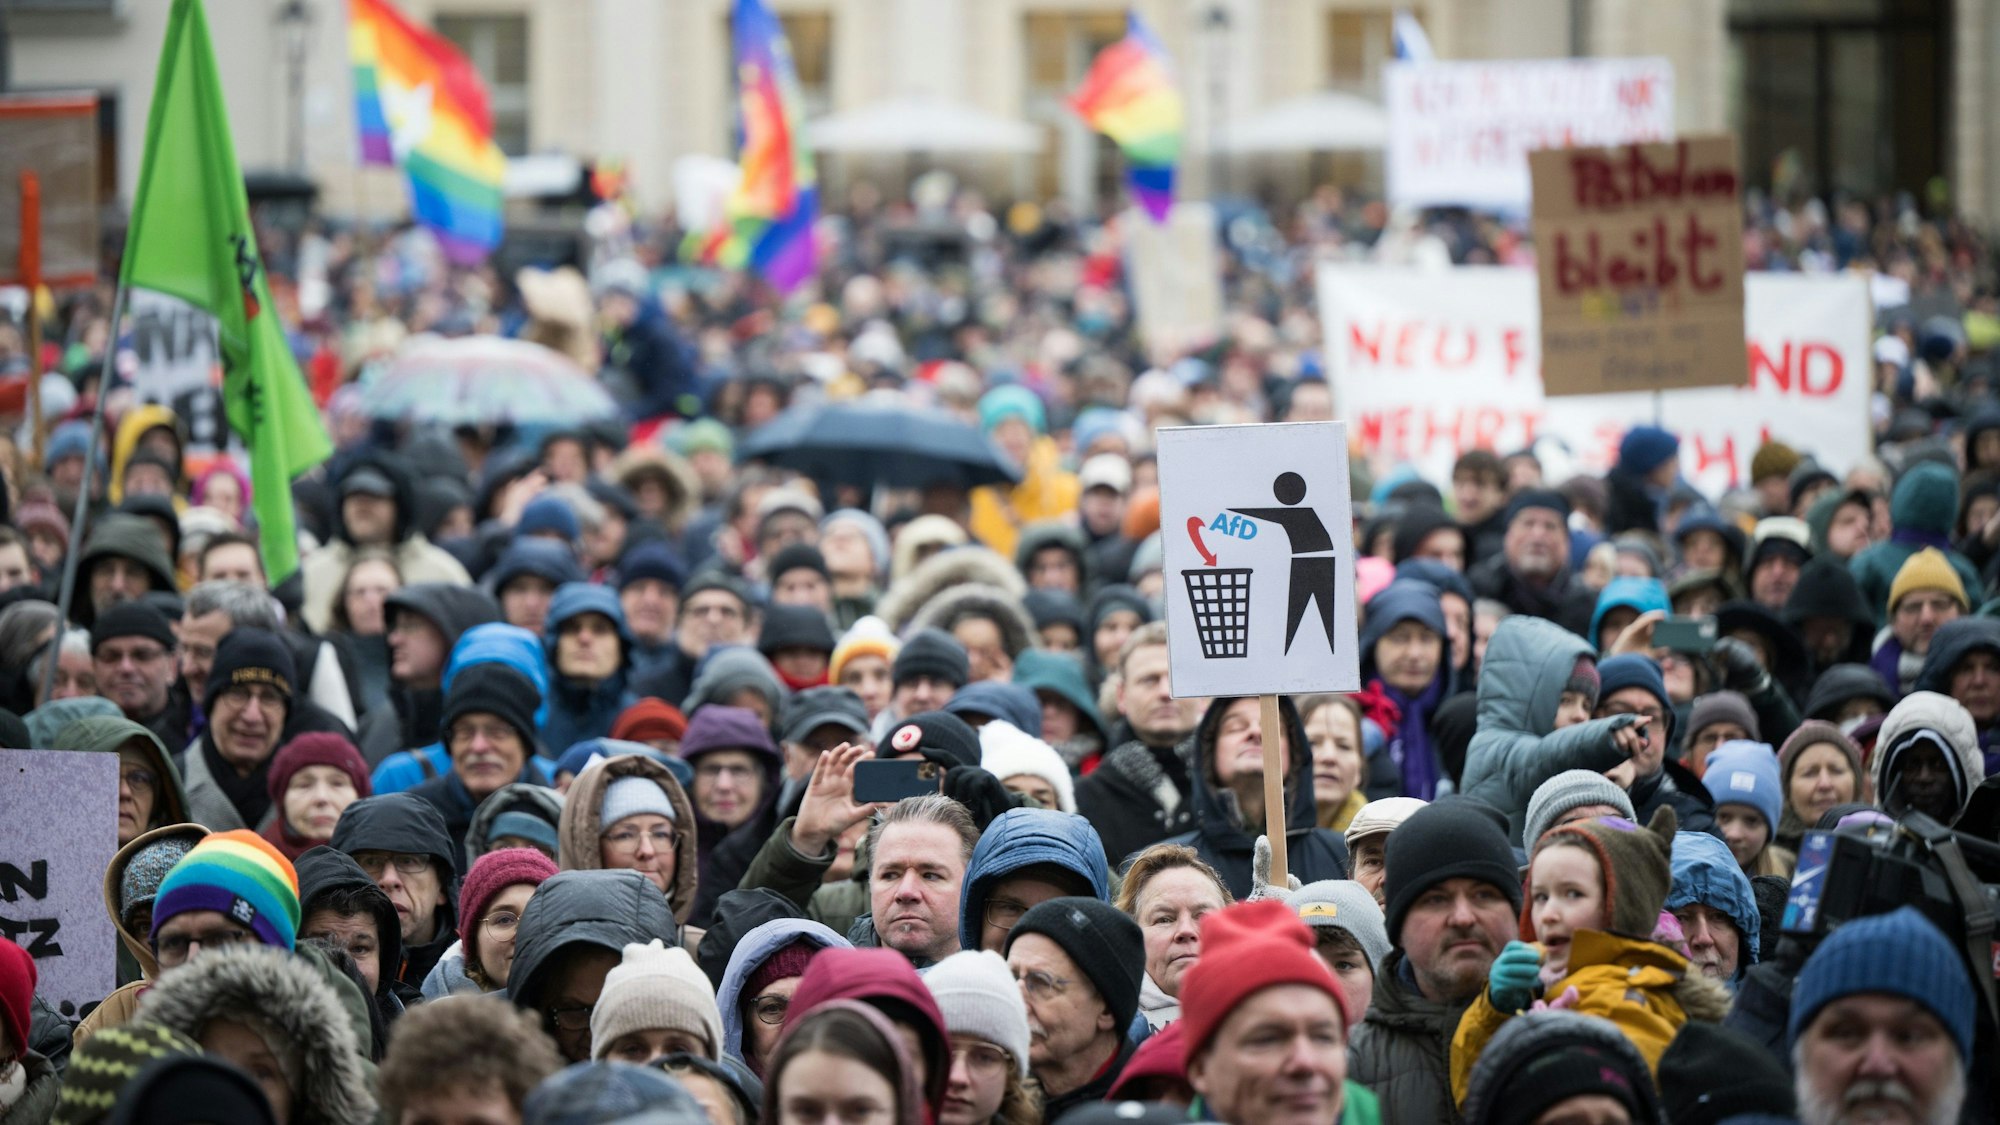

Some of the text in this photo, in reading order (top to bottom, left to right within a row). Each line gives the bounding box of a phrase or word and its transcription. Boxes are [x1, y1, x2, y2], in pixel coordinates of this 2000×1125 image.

[1554, 212, 1724, 295] bleibt
[1348, 320, 1478, 371] NEU
[1209, 513, 1258, 540] AfD
